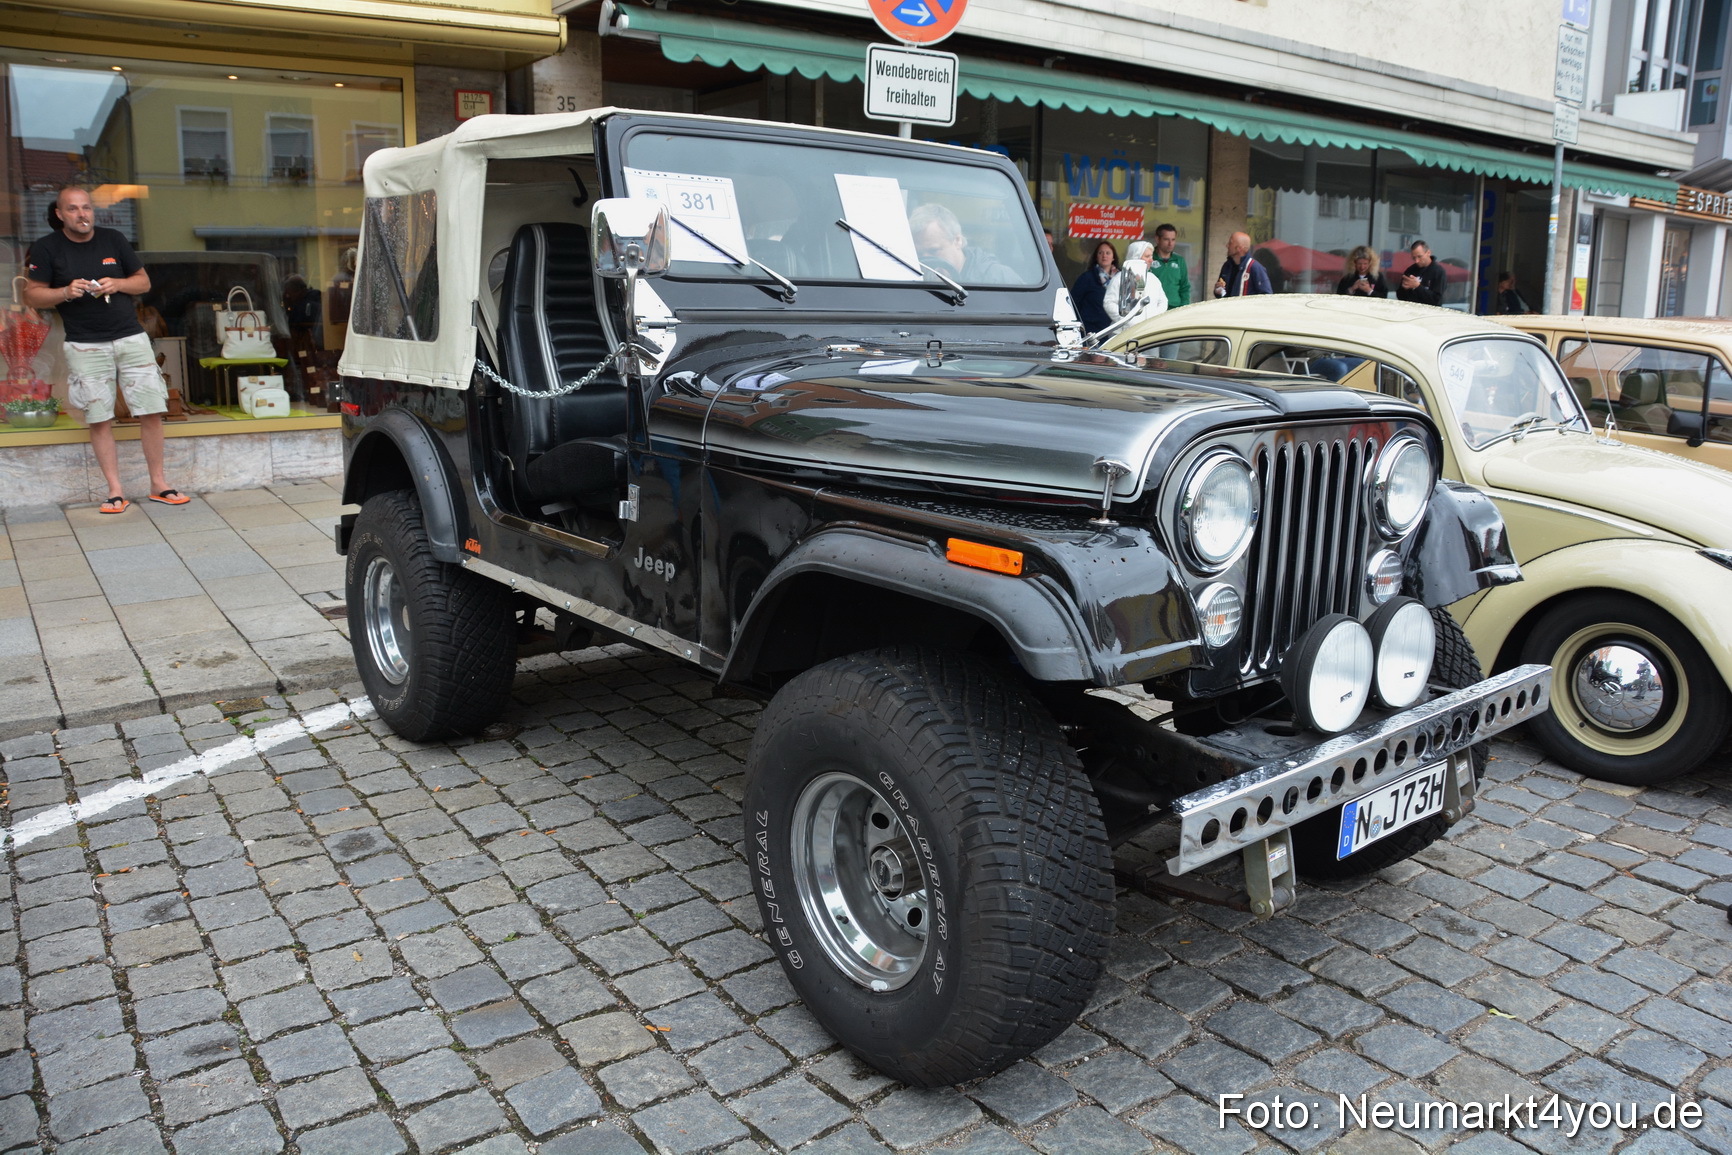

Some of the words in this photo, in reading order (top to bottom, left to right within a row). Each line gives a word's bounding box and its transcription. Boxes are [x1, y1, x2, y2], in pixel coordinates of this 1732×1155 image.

[876, 60, 949, 83] Wendebereich
[557, 96, 576, 112] 35
[886, 87, 936, 107] freihalten
[1063, 149, 1191, 206] WÖLFL
[679, 192, 716, 211] 381
[1074, 215, 1139, 228] Räumungsverkauf
[1101, 210, 1116, 218] Total
[1450, 365, 1465, 382] 549
[464, 538, 482, 554] KTM
[634, 546, 676, 582] Jeep
[1355, 800, 1373, 845] N
[756, 810, 804, 970] GENERAL
[878, 771, 947, 941] GRABBER
[933, 950, 947, 995] AT
